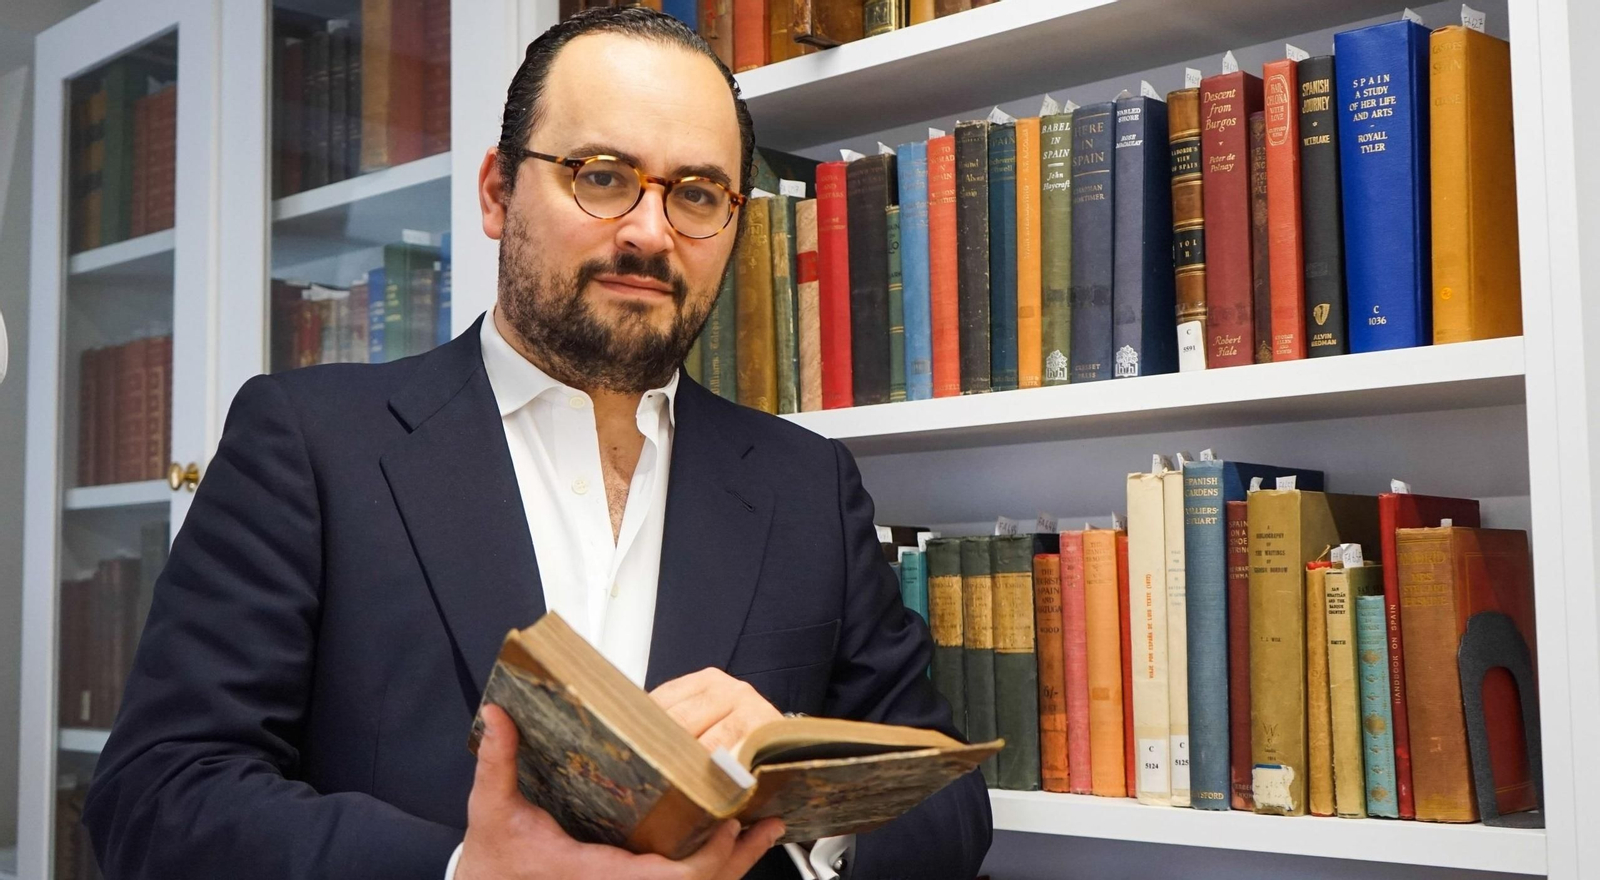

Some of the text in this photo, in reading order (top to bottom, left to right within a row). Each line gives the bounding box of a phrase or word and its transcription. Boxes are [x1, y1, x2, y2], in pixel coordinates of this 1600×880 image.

[1302, 79, 1330, 97] SPANISH
[1355, 86, 1389, 99] A STUDY
[1203, 88, 1237, 104] Descent
[1302, 96, 1330, 113] JOURNEY
[1349, 96, 1397, 111] OF HER LIFE
[1207, 102, 1232, 119] from
[1353, 108, 1393, 122] AND ARTS
[1118, 114, 1140, 123] SHORE
[1271, 113, 1284, 121] LOVE
[1041, 122, 1071, 134] BABEL
[1074, 122, 1104, 137] HERE
[1205, 117, 1237, 132] Burgos
[989, 136, 1015, 147] PAIN
[1050, 136, 1062, 145] IN
[1358, 131, 1389, 143] ROYALL
[1081, 138, 1094, 150] IN
[1361, 143, 1386, 154] TYLER
[1043, 148, 1070, 160] SPAIN
[1072, 151, 1105, 167] SPAIN
[1209, 153, 1236, 165] Peter de
[1179, 162, 1198, 171] SPAIN
[1210, 162, 1234, 173] Polnay
[1047, 170, 1064, 181] John
[1043, 179, 1071, 192] Haycraft
[1373, 305, 1380, 314] C
[1368, 317, 1387, 326] 1036
[1213, 335, 1242, 346] Robert
[1311, 339, 1337, 347] REDMAN
[1313, 333, 1333, 341] ALVIN
[1216, 345, 1238, 357] Hale
[1185, 477, 1218, 486] SPANISH
[1185, 488, 1219, 497] GARDENS
[1042, 568, 1053, 576] THE
[1391, 637, 1398, 650] ON
[1392, 655, 1401, 704] HANDBOOK
